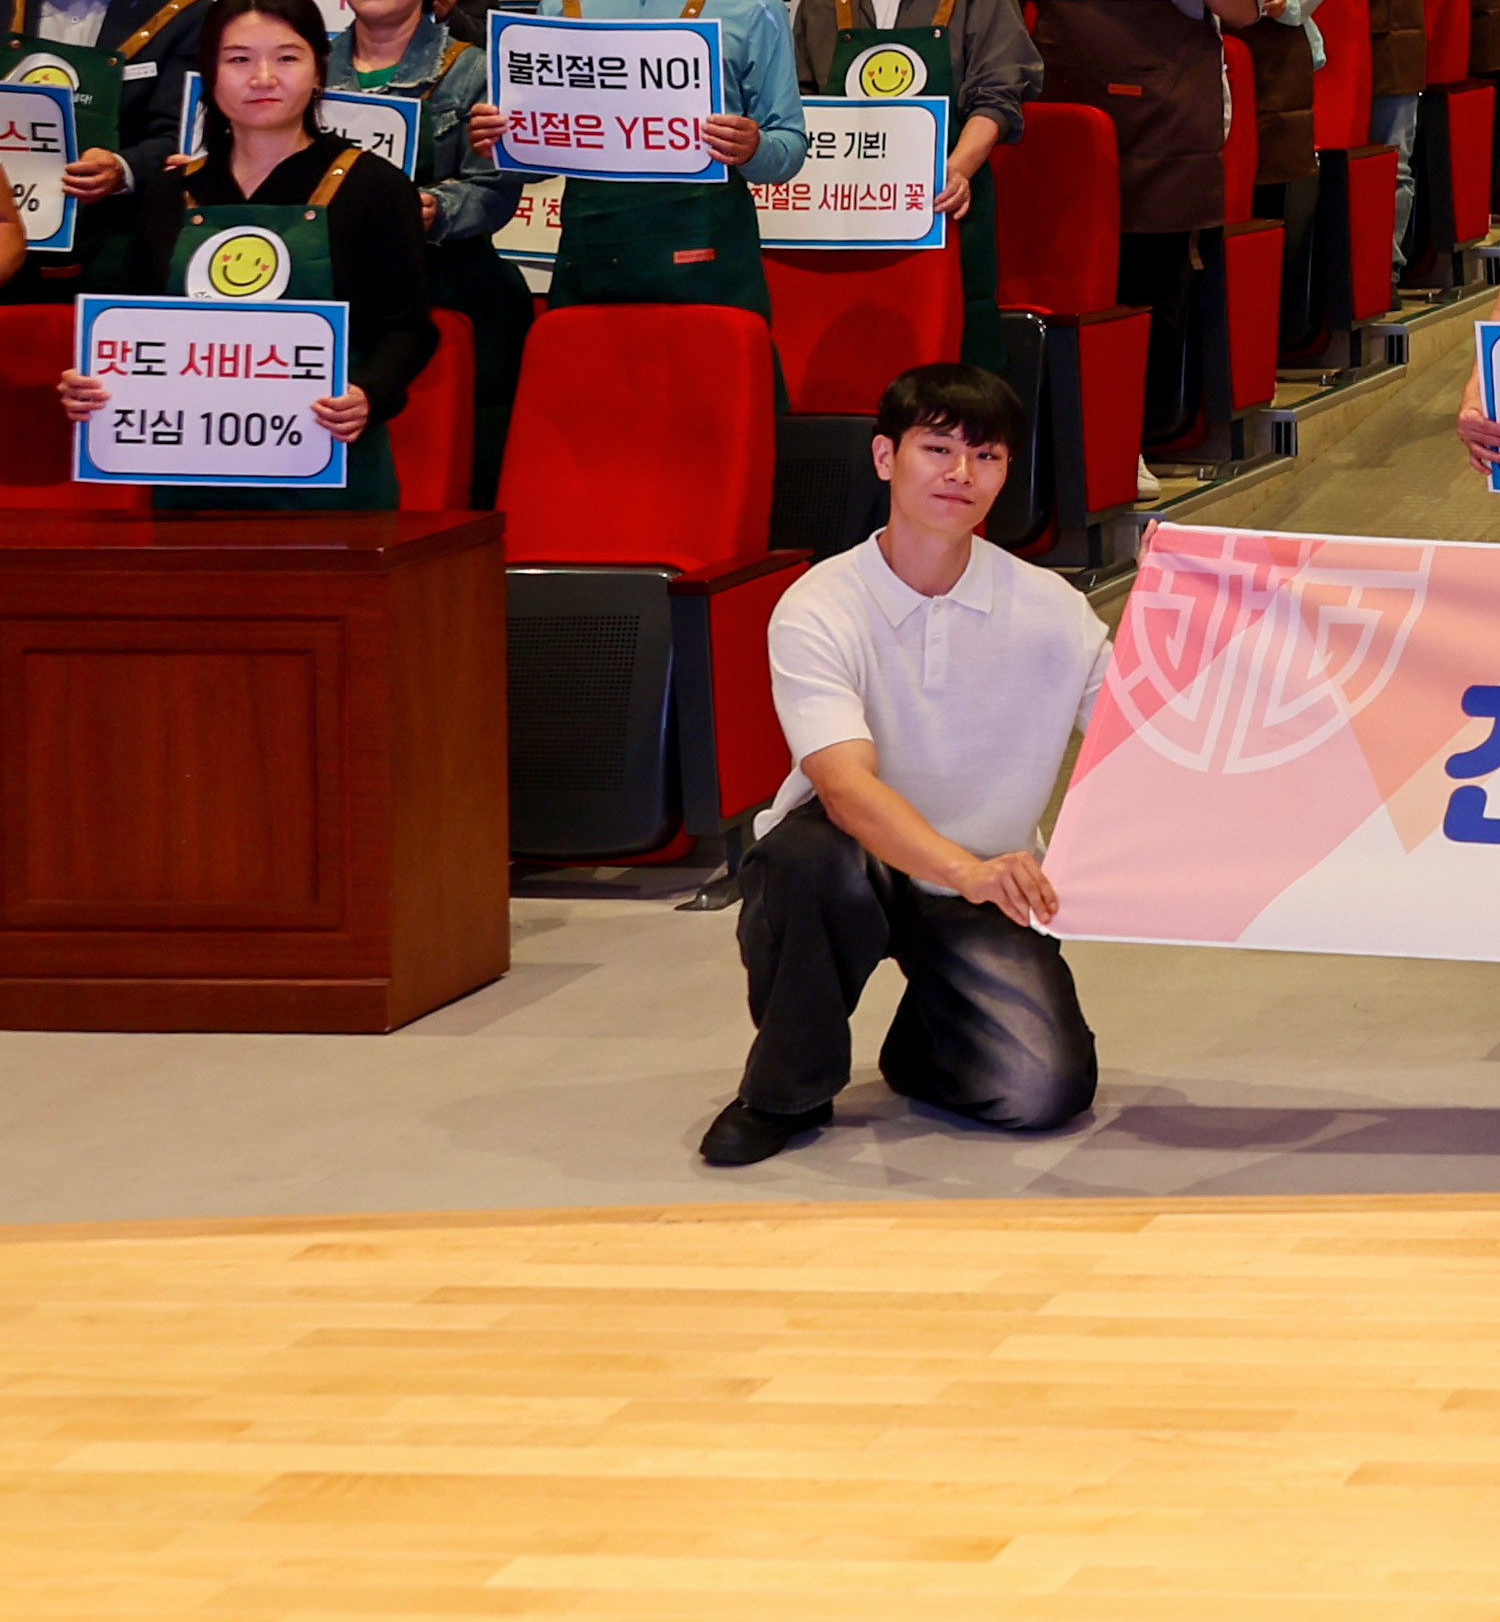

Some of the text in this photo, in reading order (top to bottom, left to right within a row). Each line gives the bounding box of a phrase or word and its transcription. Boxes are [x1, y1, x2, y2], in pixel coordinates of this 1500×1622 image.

[508, 50, 700, 89] 불친절은 NO!
[509, 111, 701, 152] 친절은 YES!
[844, 132, 886, 159] 기본!
[818, 183, 897, 211] 서비스의
[905, 184, 924, 210] 꽃
[97, 340, 326, 380] 맛도 서비스도
[113, 409, 302, 446] 진심 100%
